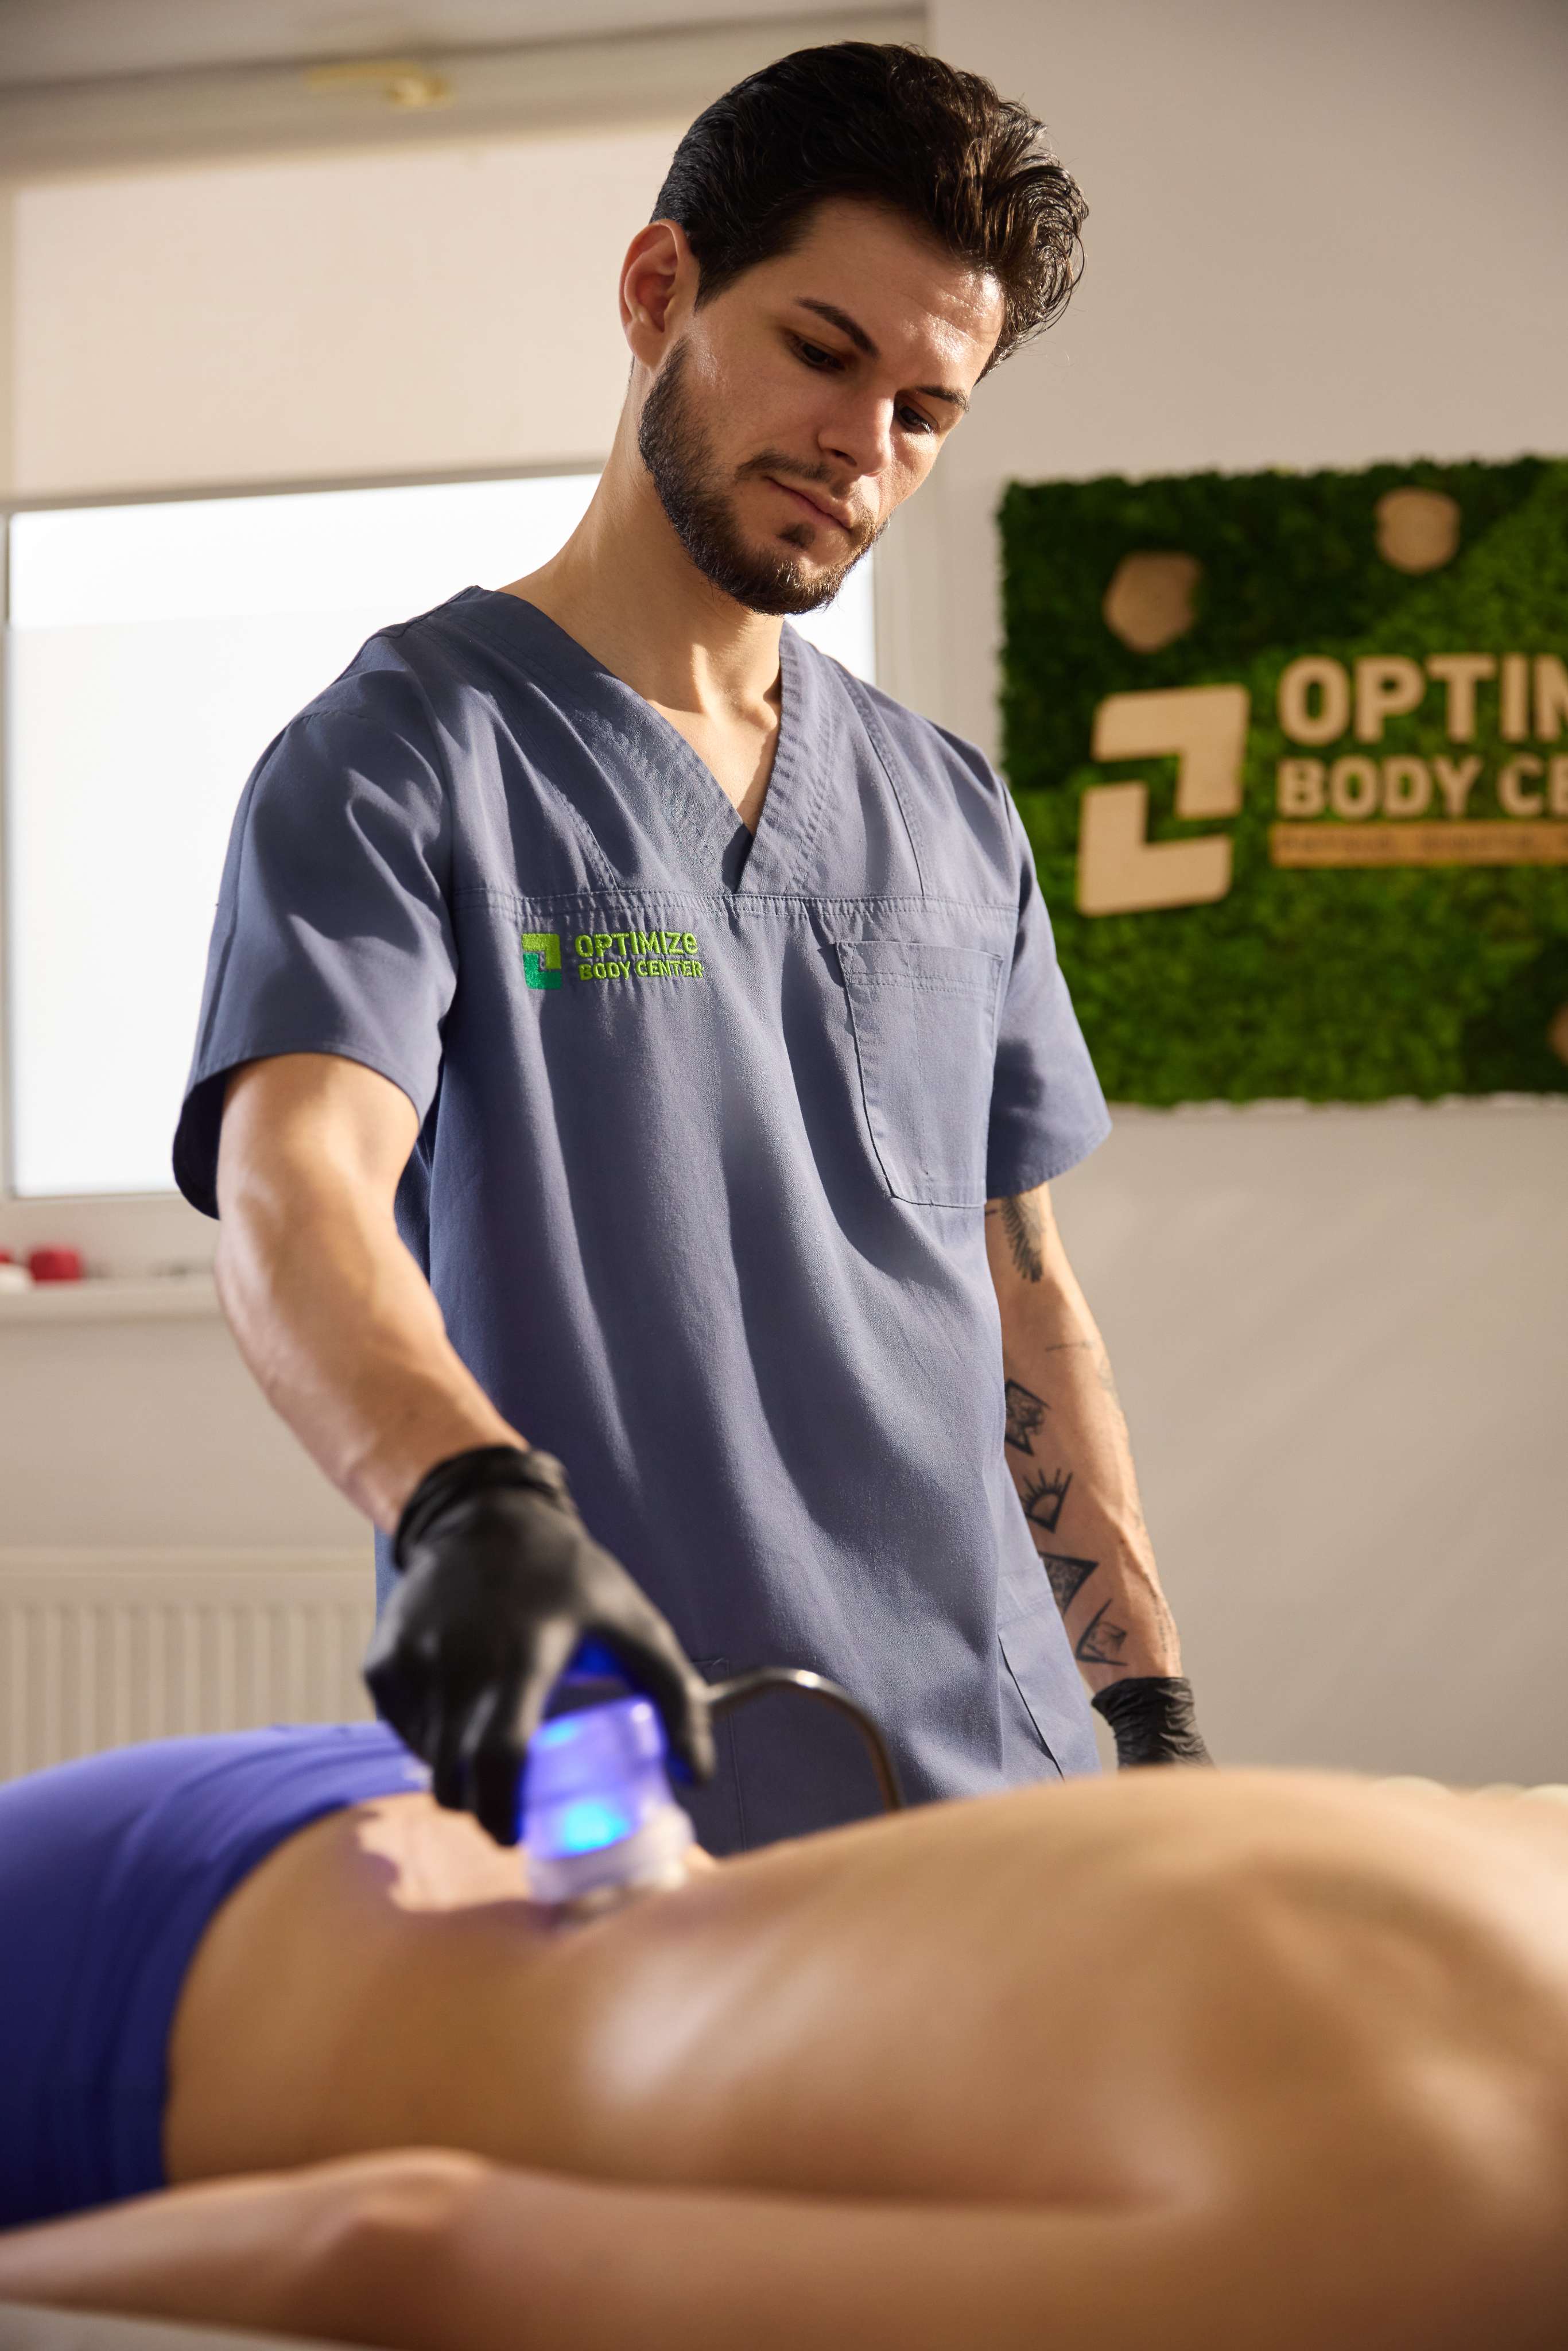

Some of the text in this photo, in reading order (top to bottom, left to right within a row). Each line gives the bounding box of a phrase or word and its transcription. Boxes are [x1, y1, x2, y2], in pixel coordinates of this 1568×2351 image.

[1278, 756, 1481, 819] BODY
[579, 960, 703, 980] BODY CENTER
